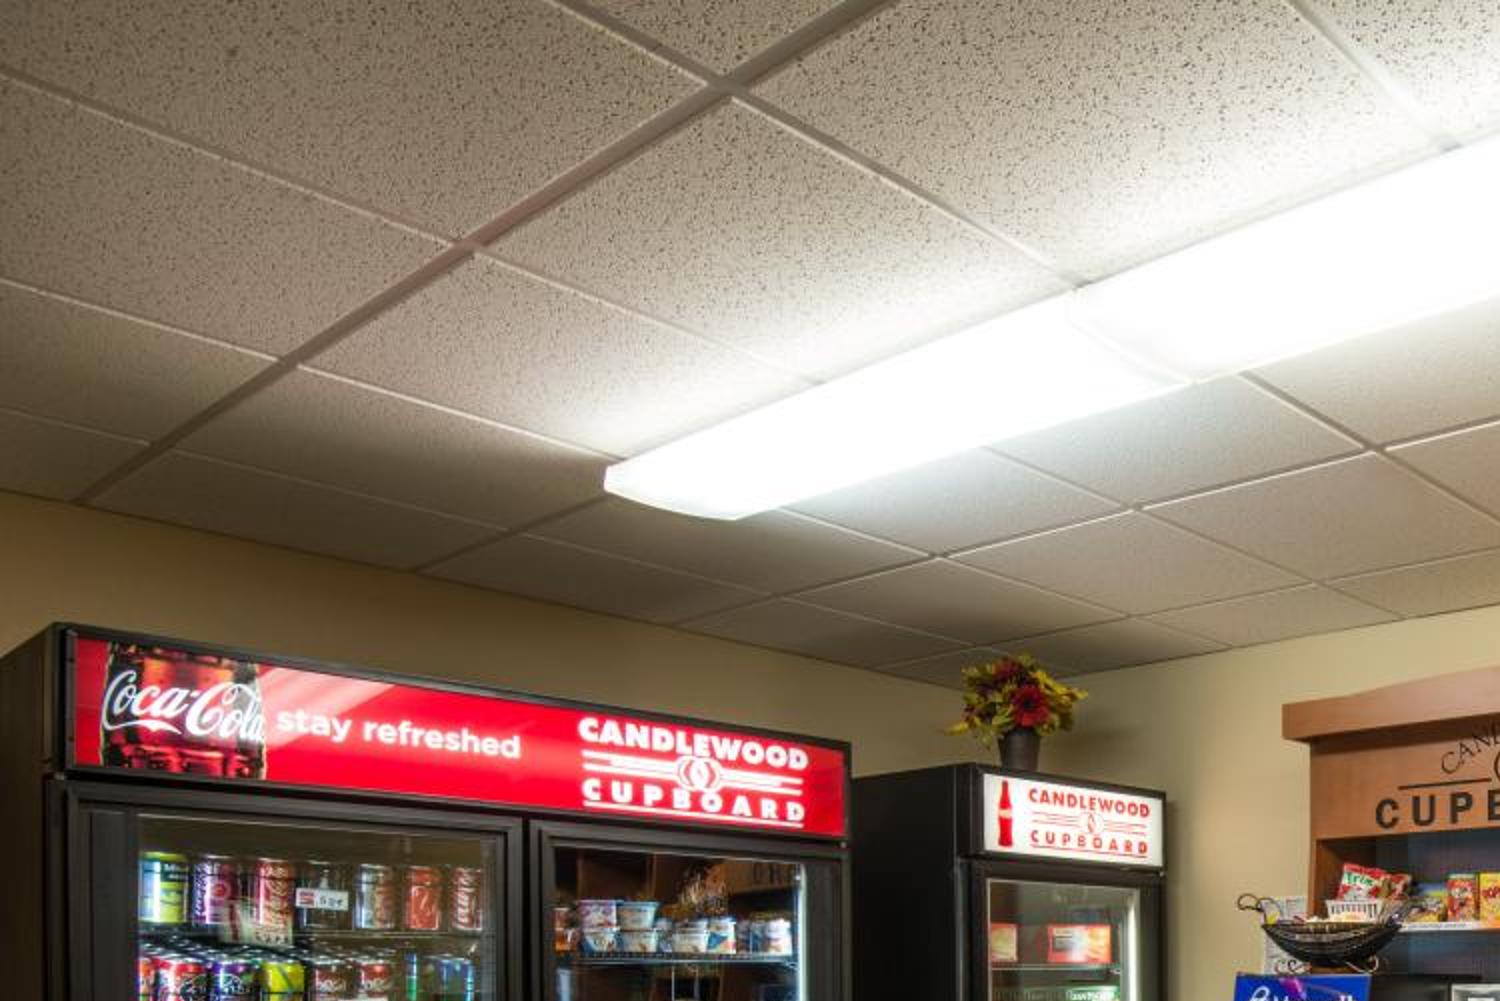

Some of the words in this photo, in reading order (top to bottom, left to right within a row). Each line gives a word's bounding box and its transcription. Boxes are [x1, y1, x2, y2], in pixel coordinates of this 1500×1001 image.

[101, 669, 266, 742] Coca-Cola
[277, 709, 353, 742] stay
[363, 718, 521, 759] refreshed
[578, 717, 809, 770] CANDLEWOOD
[582, 778, 805, 821] CUPBOARD
[1028, 788, 1151, 818] CANDLEWOOD
[1030, 829, 1149, 854] CUPBOARD
